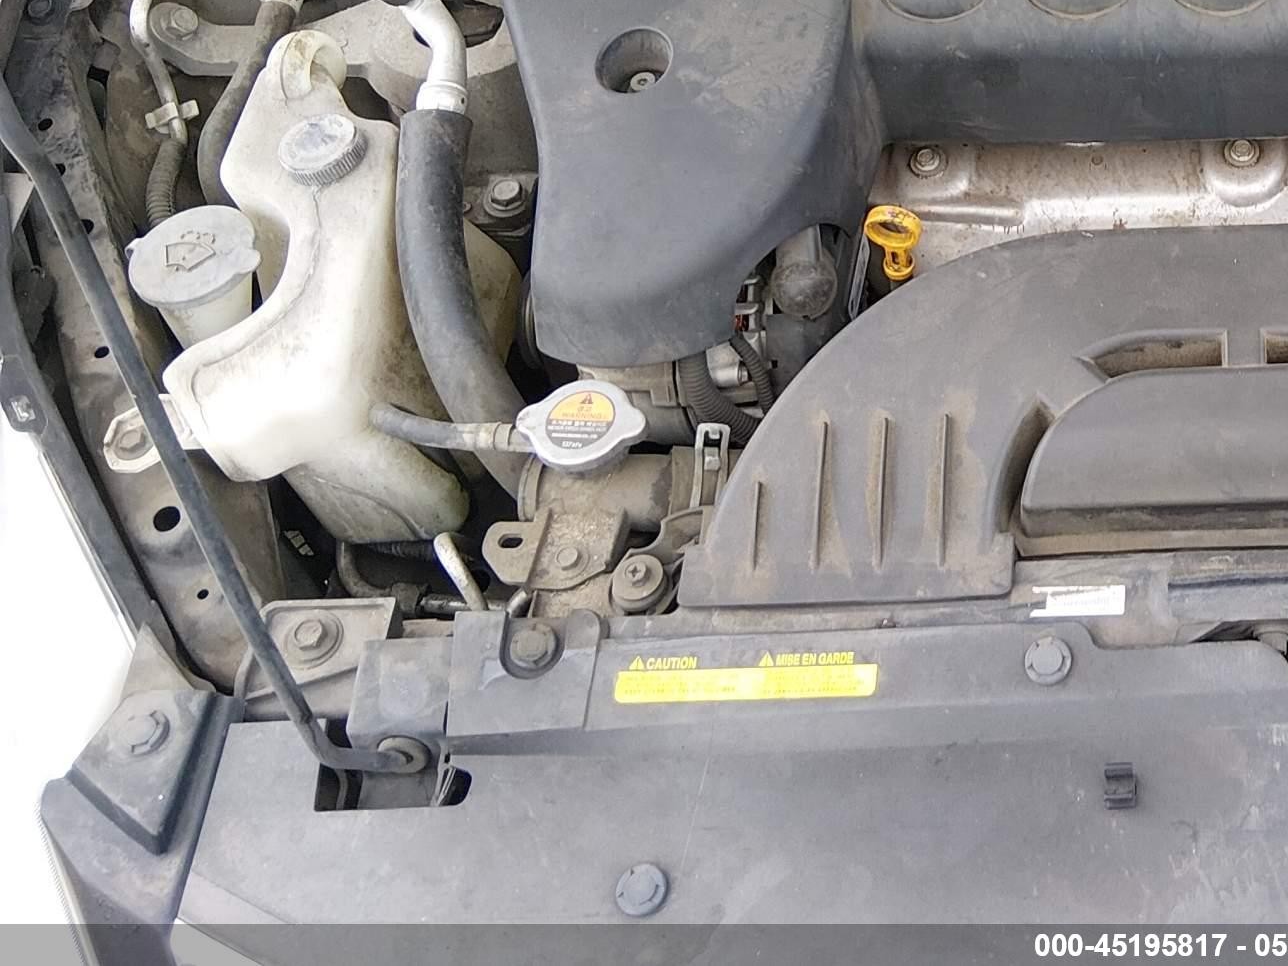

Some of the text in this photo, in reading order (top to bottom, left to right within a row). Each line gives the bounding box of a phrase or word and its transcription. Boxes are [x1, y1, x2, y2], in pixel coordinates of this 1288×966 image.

[646, 656, 698, 670] CAUTION
[775, 651, 855, 666] MISE EN GARDE
